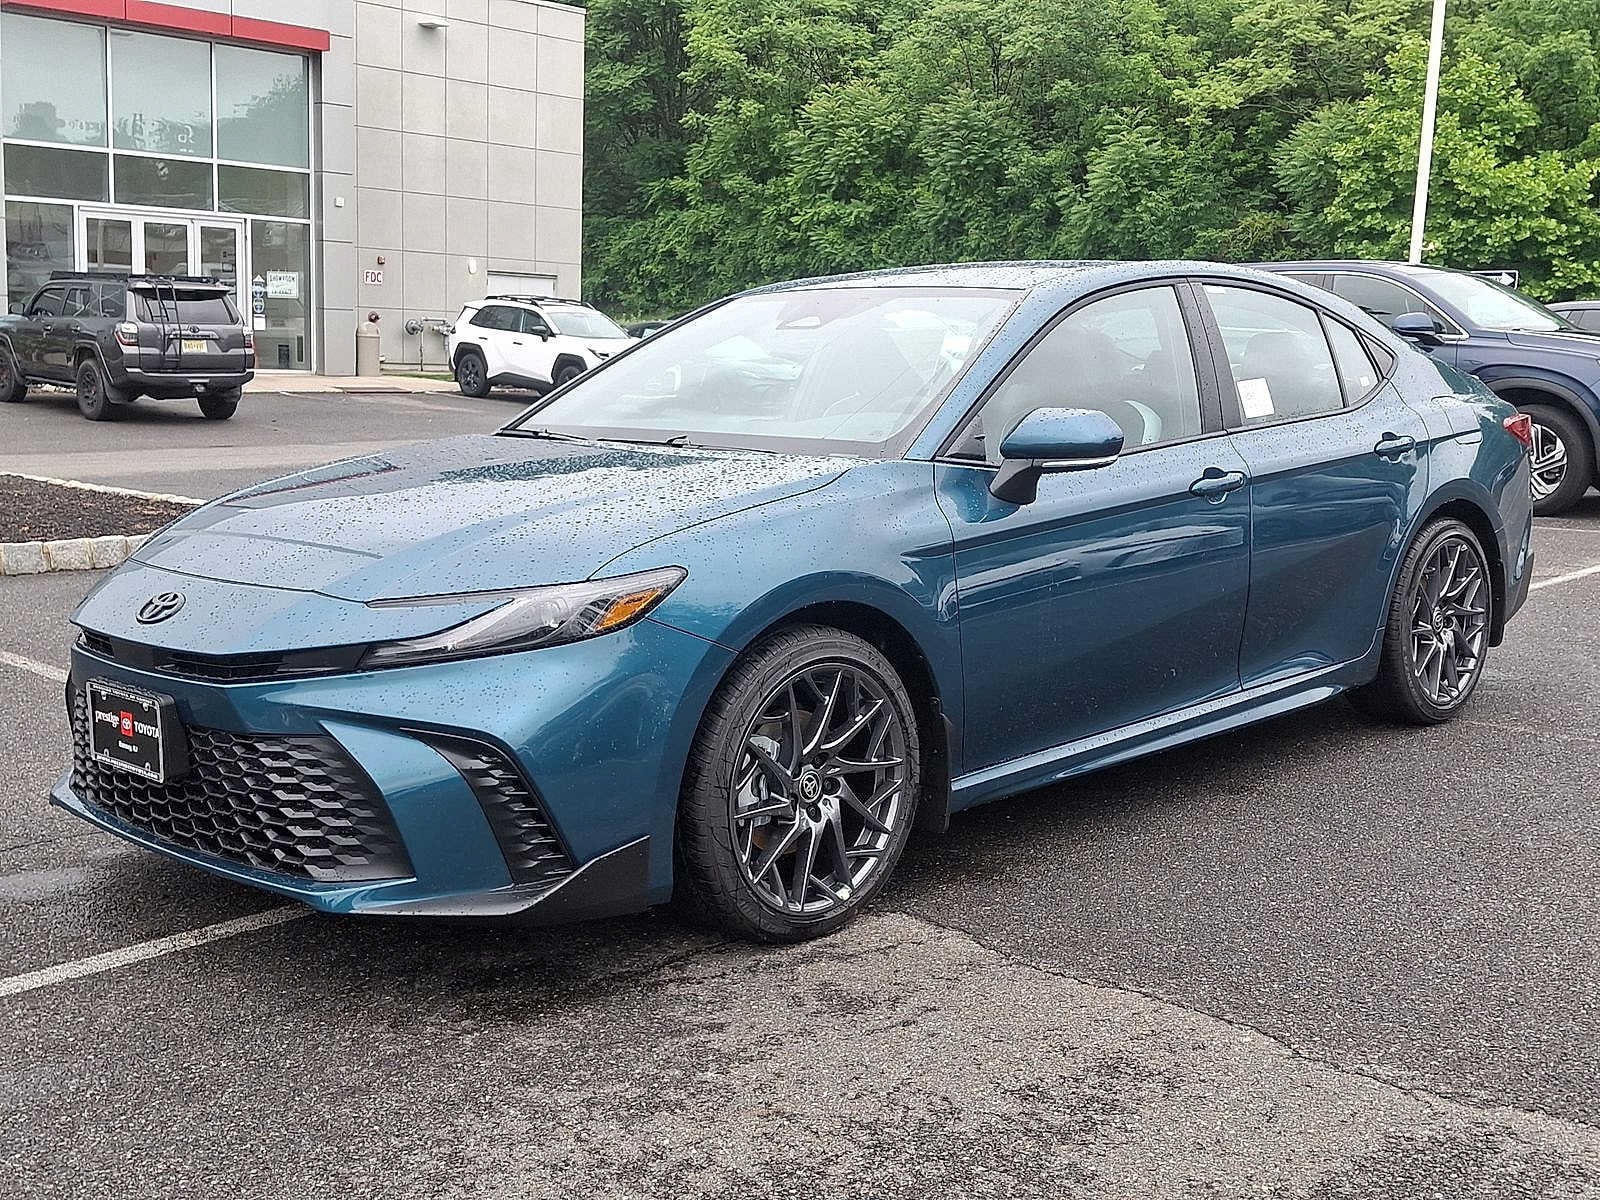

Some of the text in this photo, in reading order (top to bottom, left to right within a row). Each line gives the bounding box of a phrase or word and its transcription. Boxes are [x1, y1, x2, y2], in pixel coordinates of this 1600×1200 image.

[365, 271, 382, 283] FDC
[95, 710, 160, 738] prestige TOYOTA
